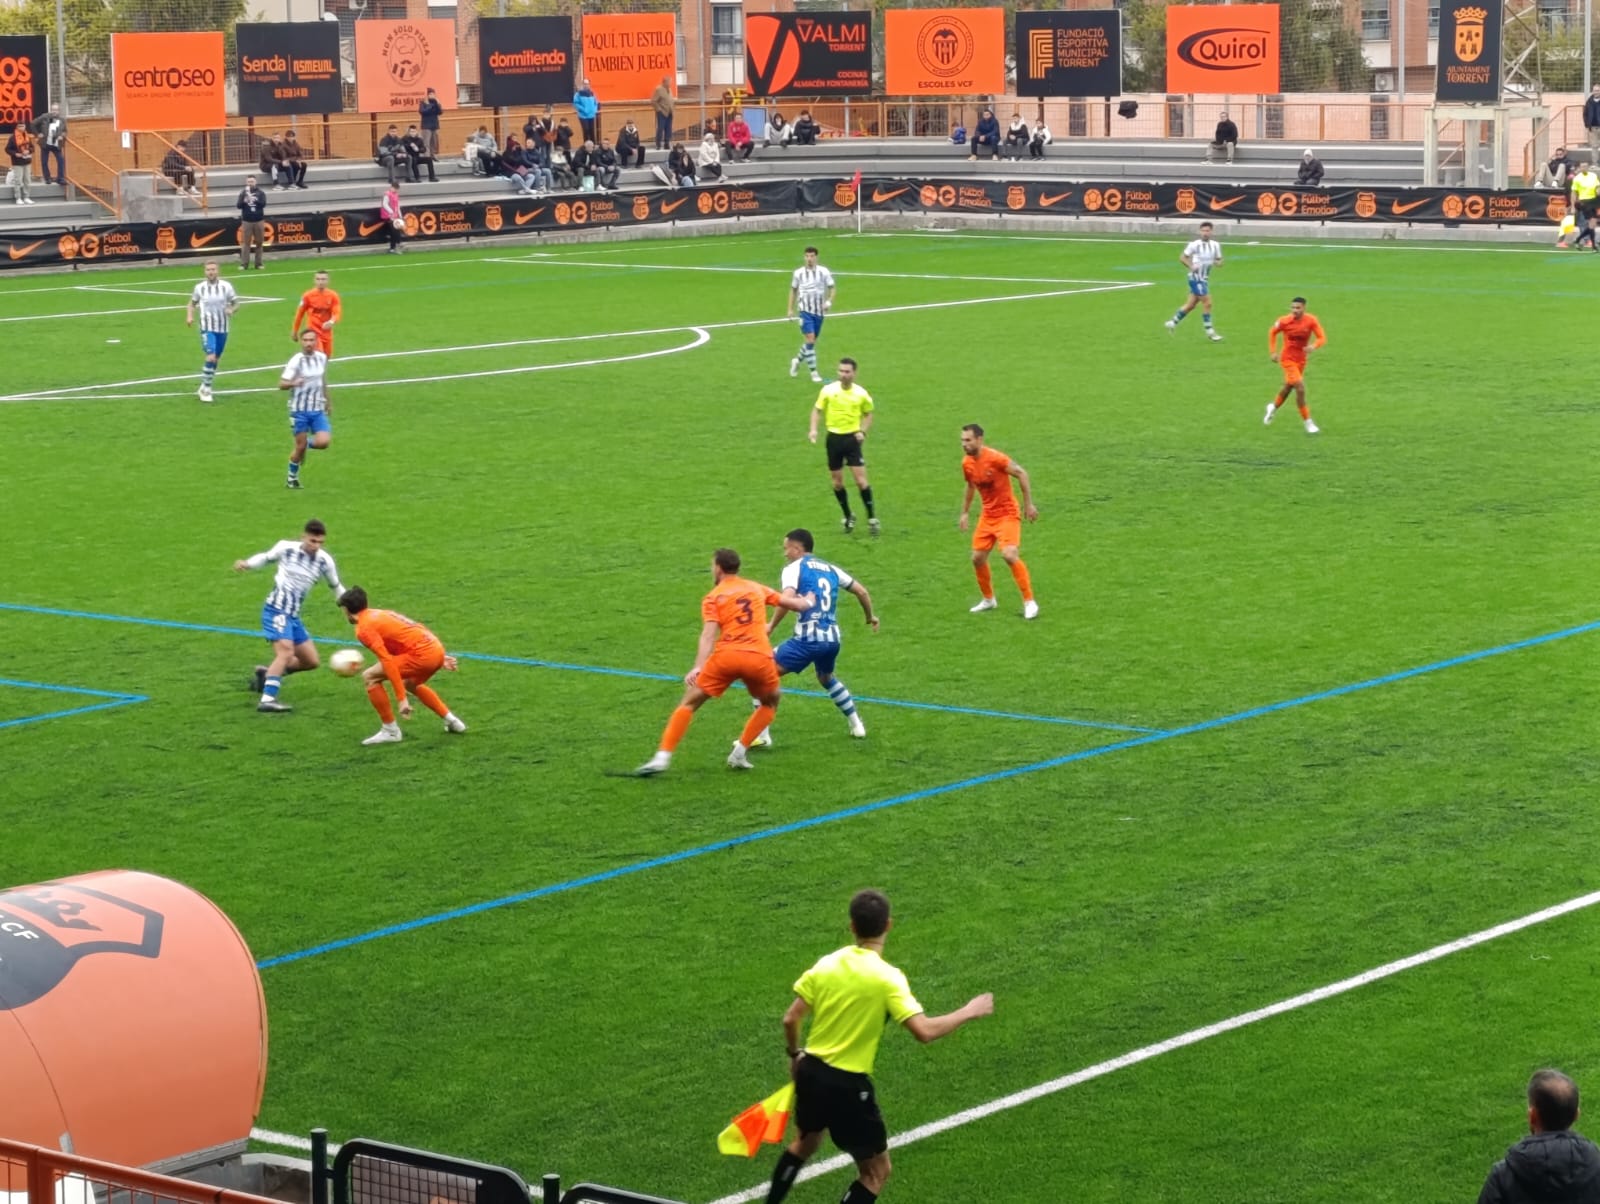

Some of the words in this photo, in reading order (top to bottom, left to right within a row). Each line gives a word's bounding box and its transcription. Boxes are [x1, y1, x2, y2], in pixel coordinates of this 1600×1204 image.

[797, 23, 867, 43] VALMI
[1056, 26, 1105, 38] FUNDACIÓ
[618, 32, 635, 49] TU
[636, 30, 674, 48] ESTILO
[1057, 38, 1109, 48] ESPORTIVA
[829, 43, 866, 52] TORRENT
[1057, 47, 1109, 58] MUNICIPAL
[1199, 37, 1266, 61] Quirol
[242, 54, 287, 73] Senda
[489, 48, 566, 68] dormitienda
[586, 52, 634, 73] TAMBIÉN
[1057, 57, 1100, 68] TORRENT
[837, 71, 868, 79] COCINAS
[1445, 73, 1491, 84] TORRENT
[793, 78, 826, 88] ALMACÉN
[918, 81, 955, 89] ESCOLES
[957, 80, 974, 88] VCF
[1125, 190, 1152, 201] Fútbol
[590, 200, 614, 211] Fútbol
[1125, 200, 1159, 211] Emotion
[1489, 196, 1520, 208] Fútbol
[1301, 204, 1338, 215] Emotion
[1489, 208, 1528, 218] Emotion
[439, 210, 465, 222] Fútbol
[590, 211, 621, 222] Emotion
[277, 221, 305, 233] Fútbol
[439, 221, 472, 232] Emotion
[102, 231, 132, 243] Fútbol
[278, 232, 312, 244] Emotion
[103, 243, 140, 256] Emotion
[817, 577, 832, 611] 3
[734, 597, 754, 625] 3
[1, 922, 39, 939] CF
